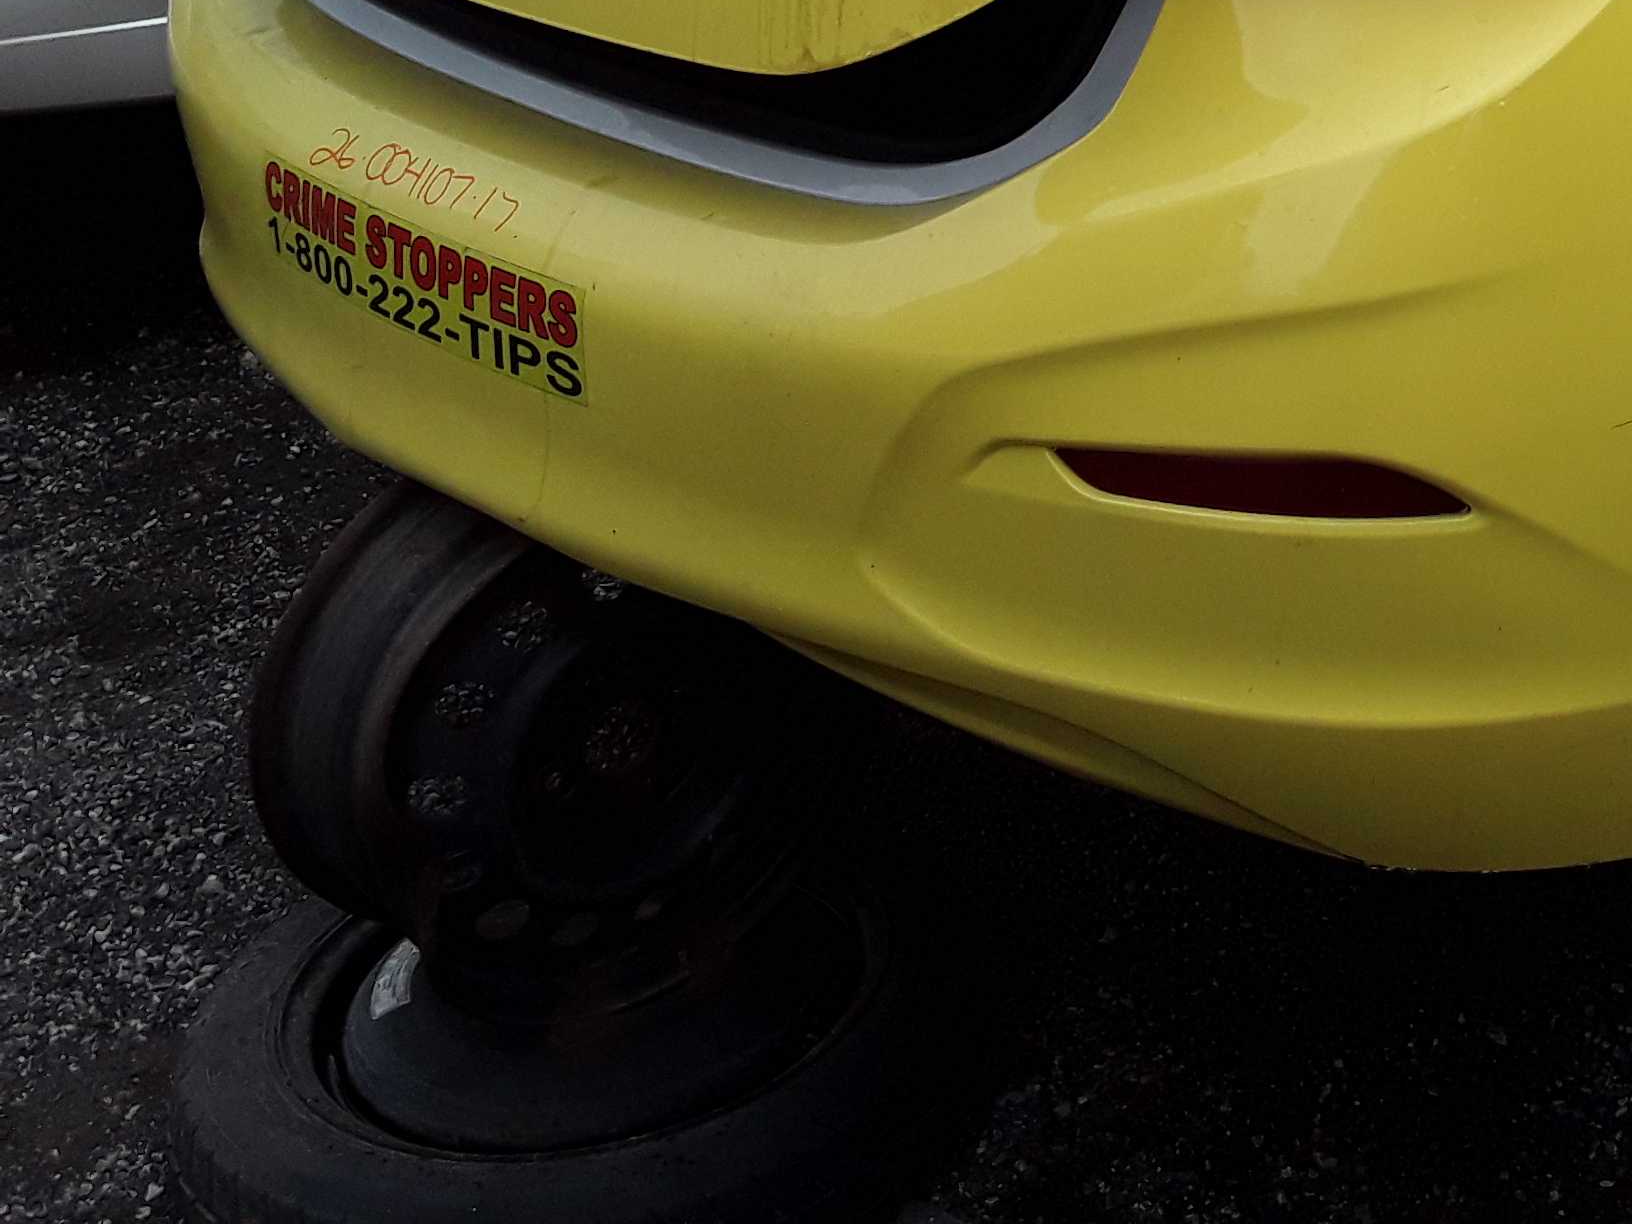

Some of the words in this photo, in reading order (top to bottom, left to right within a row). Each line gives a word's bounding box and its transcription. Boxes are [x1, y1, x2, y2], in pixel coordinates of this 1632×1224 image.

[265, 161, 358, 256] CRIME
[365, 214, 579, 348] STOPPERS
[267, 216, 584, 398] 1-800-222-TIPS
